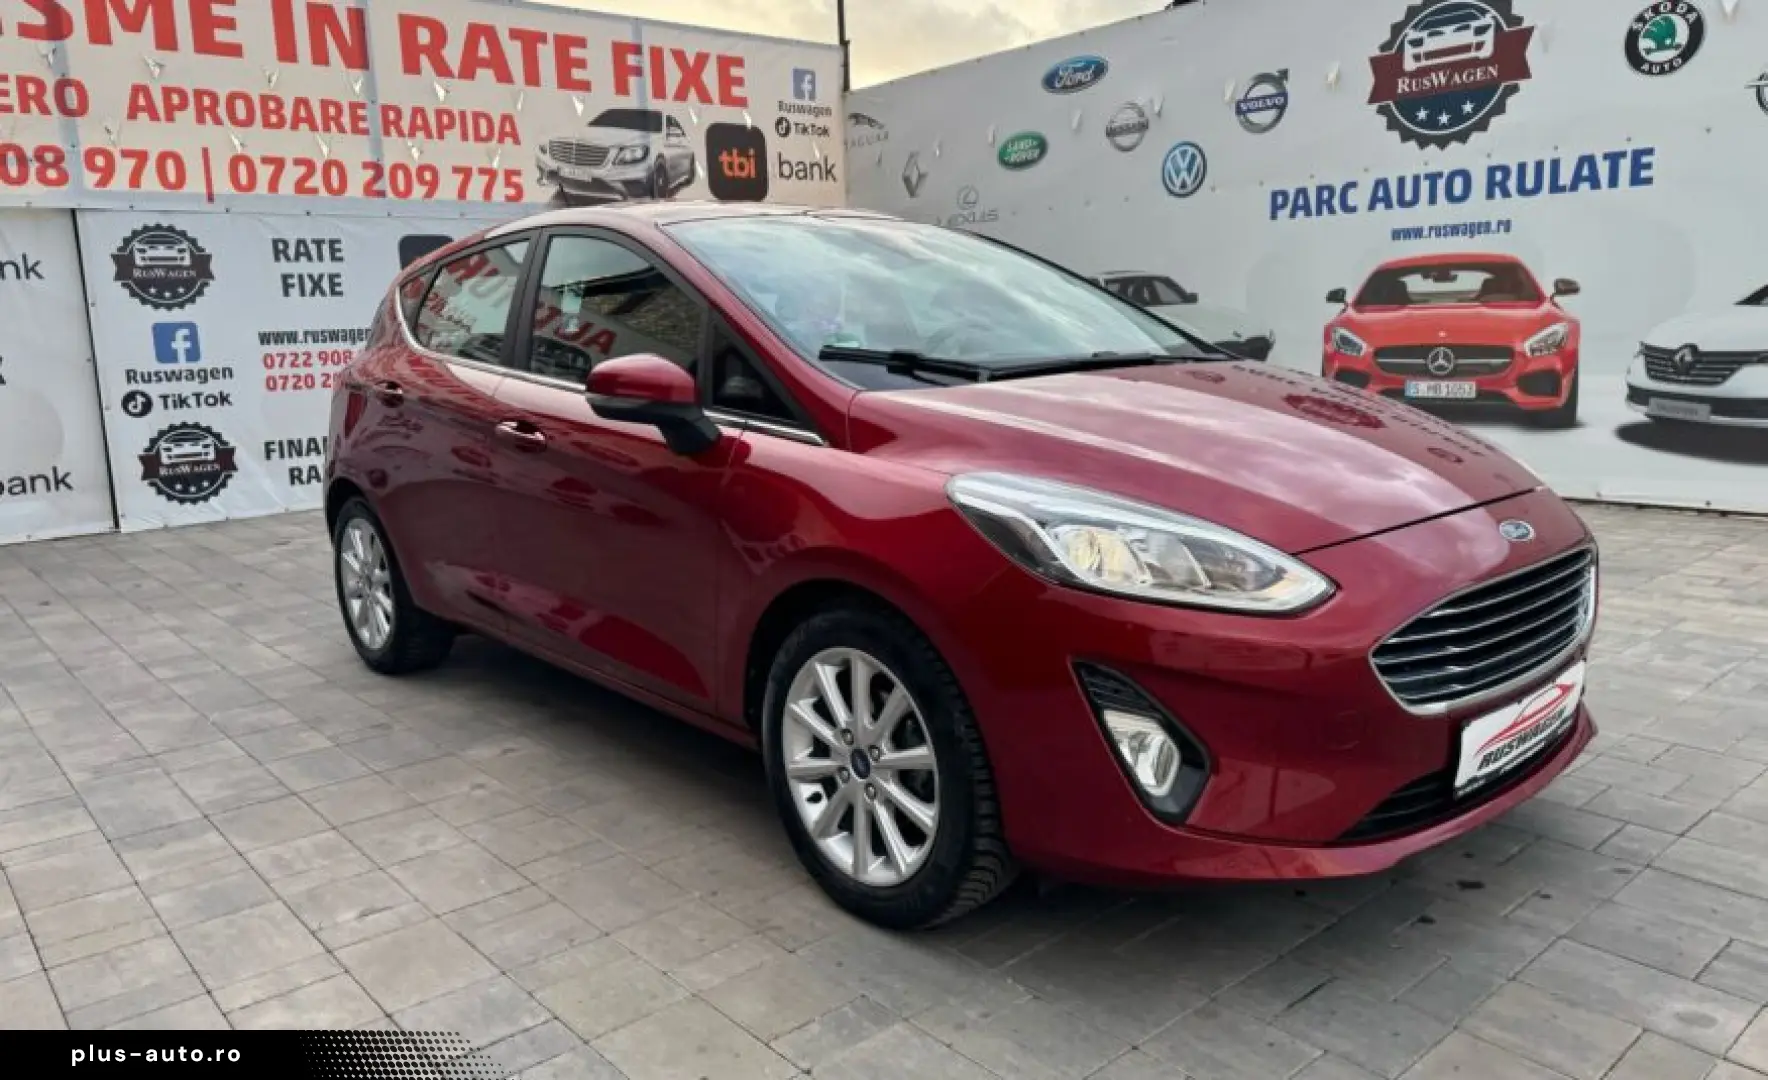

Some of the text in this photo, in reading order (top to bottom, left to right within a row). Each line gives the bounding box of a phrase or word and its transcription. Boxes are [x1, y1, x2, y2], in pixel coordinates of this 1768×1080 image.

[271, 0, 371, 71] IN
[397, 13, 592, 93] RATE
[611, 41, 749, 108] FIXE
[126, 84, 370, 136] APROBARE
[381, 103, 521, 146] RAPIDA
[794, 122, 830, 137] TikTok
[0, 143, 70, 187] 08
[84, 147, 187, 191] 970
[228, 154, 348, 197] 0720
[361, 161, 440, 199] 209
[451, 166, 524, 202] 775
[718, 147, 837, 182] tbi bank
[1270, 147, 1656, 221] PARC AUTO RULATE
[1391, 218, 1512, 241] www.ruswagen.ro
[271, 237, 344, 263] RATE
[280, 272, 344, 298] FIXE
[263, 352, 314, 370] 0722
[125, 366, 234, 385] Ruswagen
[265, 373, 316, 392] 0720
[158, 390, 234, 411] TikTok
[0, 465, 74, 496] ank
